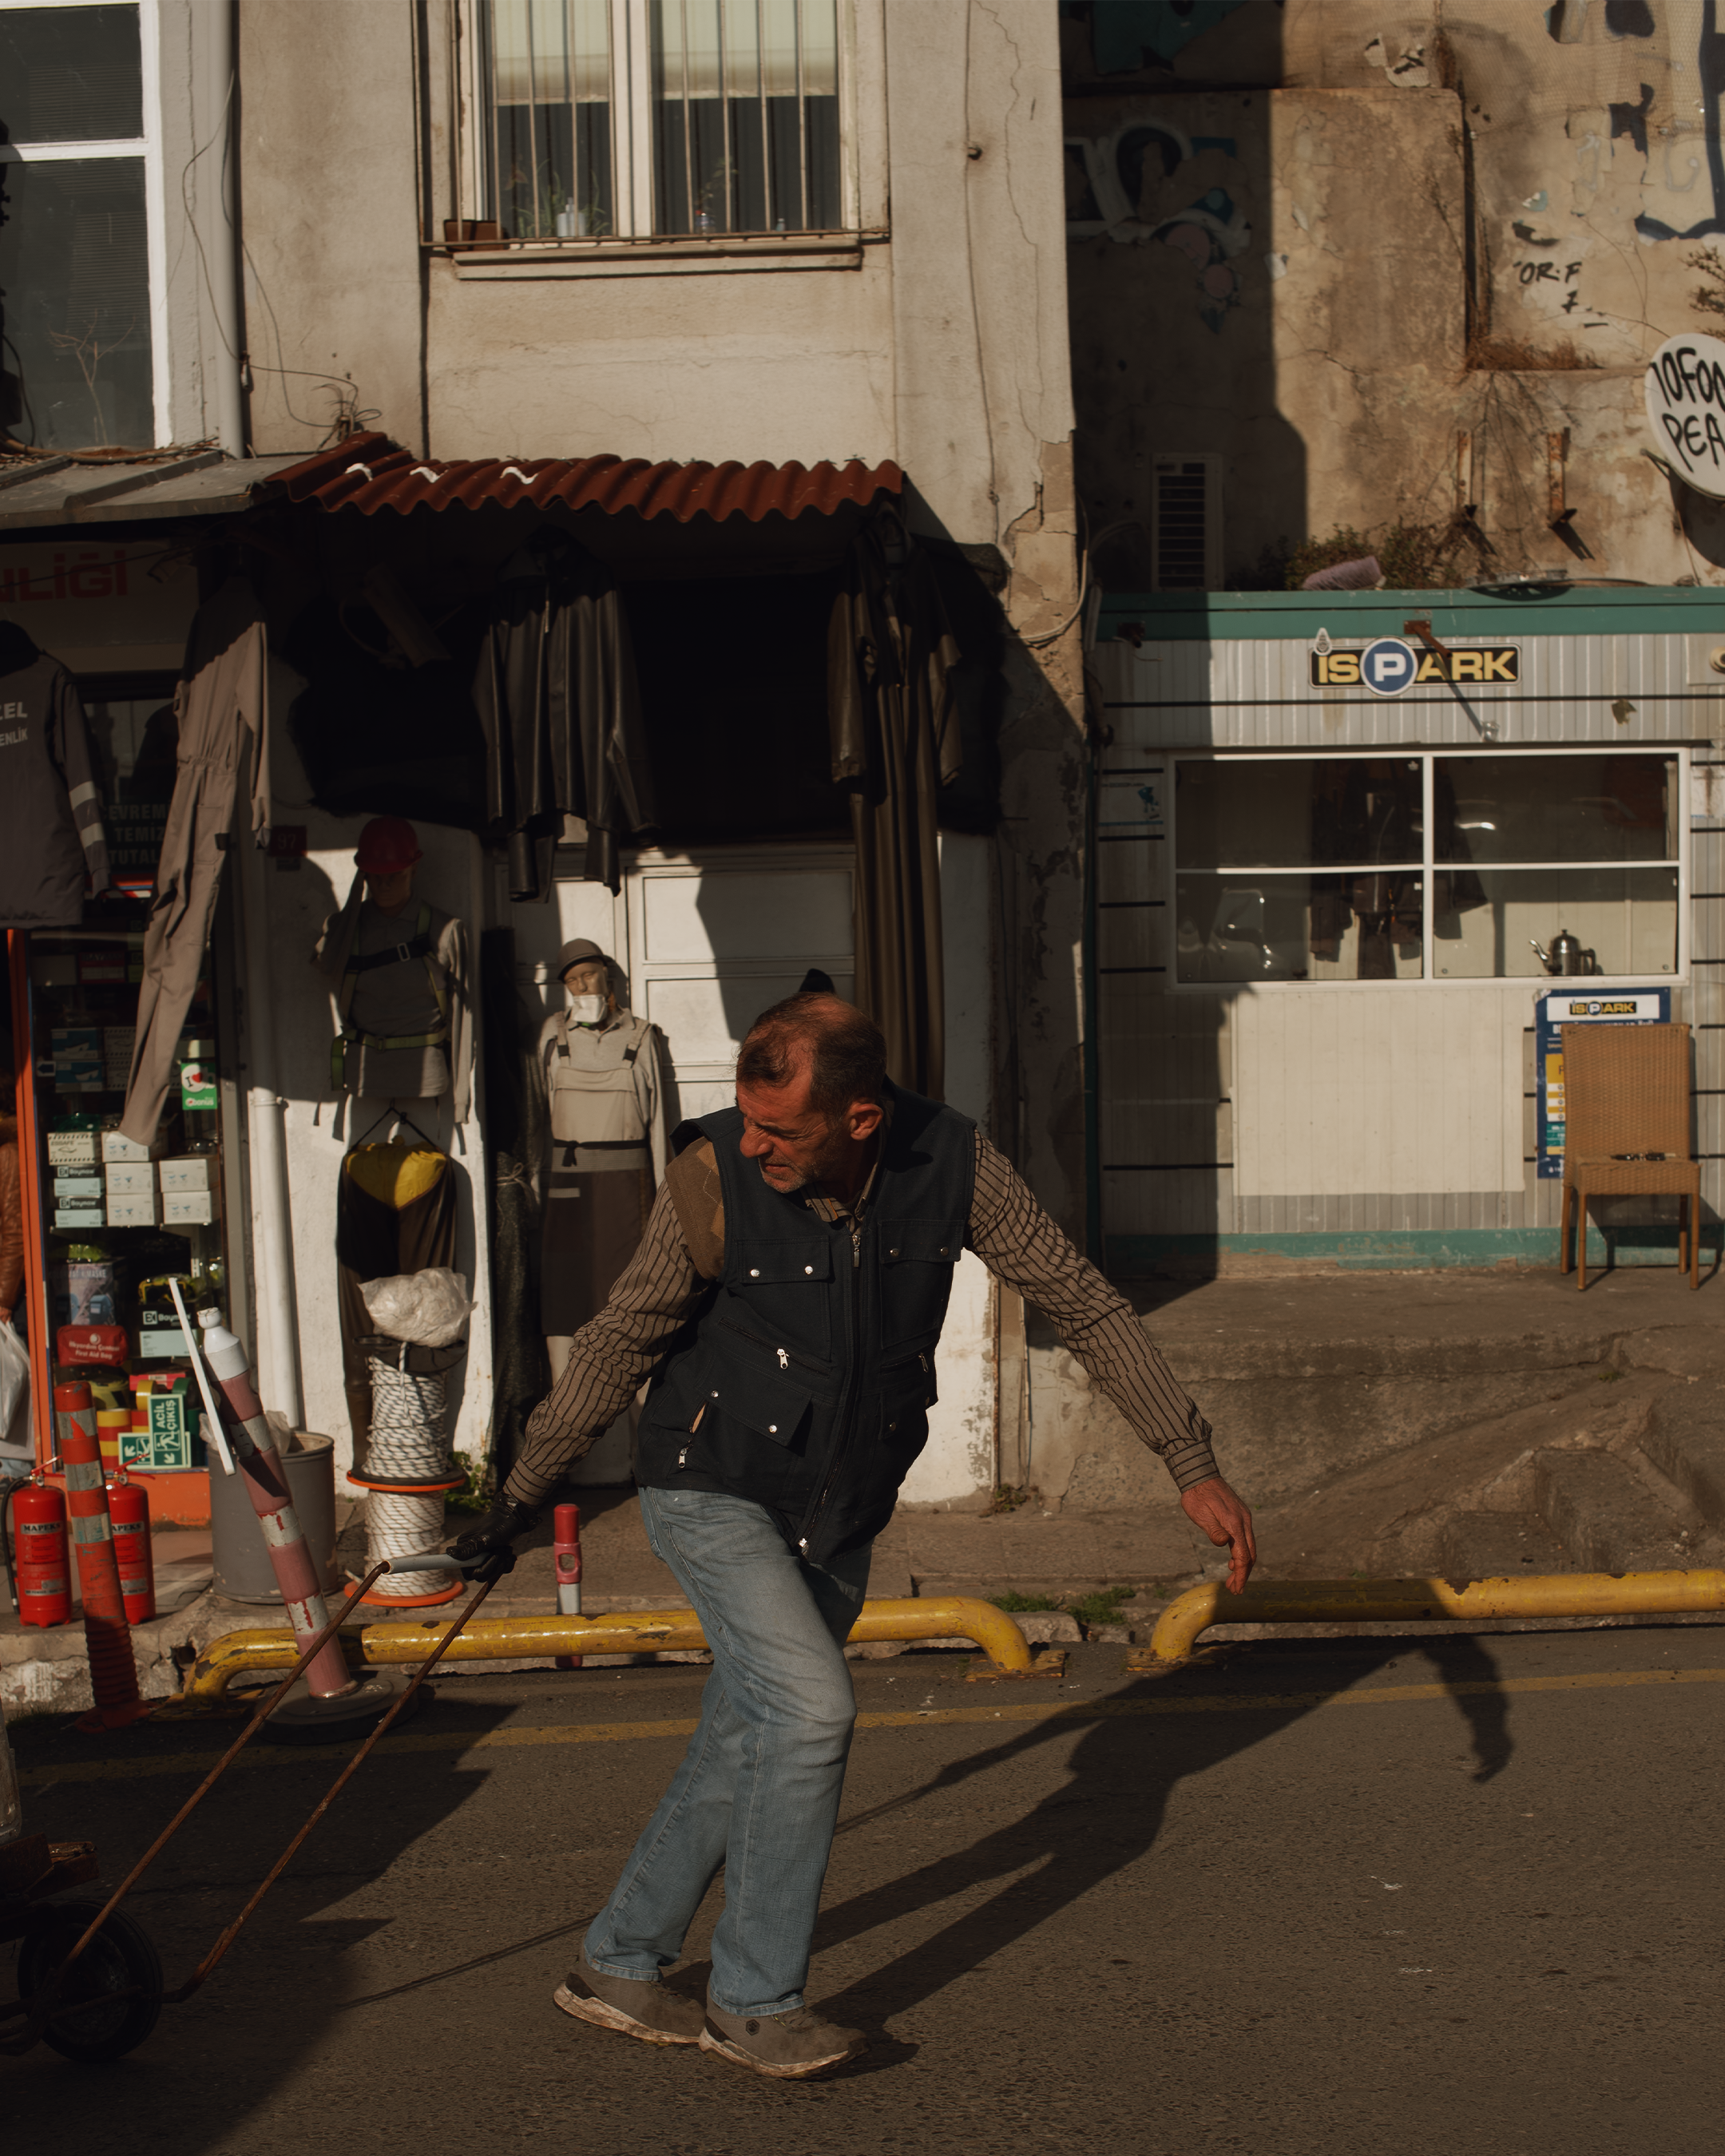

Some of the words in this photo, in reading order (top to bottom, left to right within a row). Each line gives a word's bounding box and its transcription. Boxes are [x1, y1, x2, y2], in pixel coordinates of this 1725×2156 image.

[0, 701, 28, 720] EL
[104, 800, 171, 821] EVREM
[277, 833, 296, 850] 97
[153, 1402, 165, 1429] ACİL
[24, 1523, 61, 1532] MAPEKS
